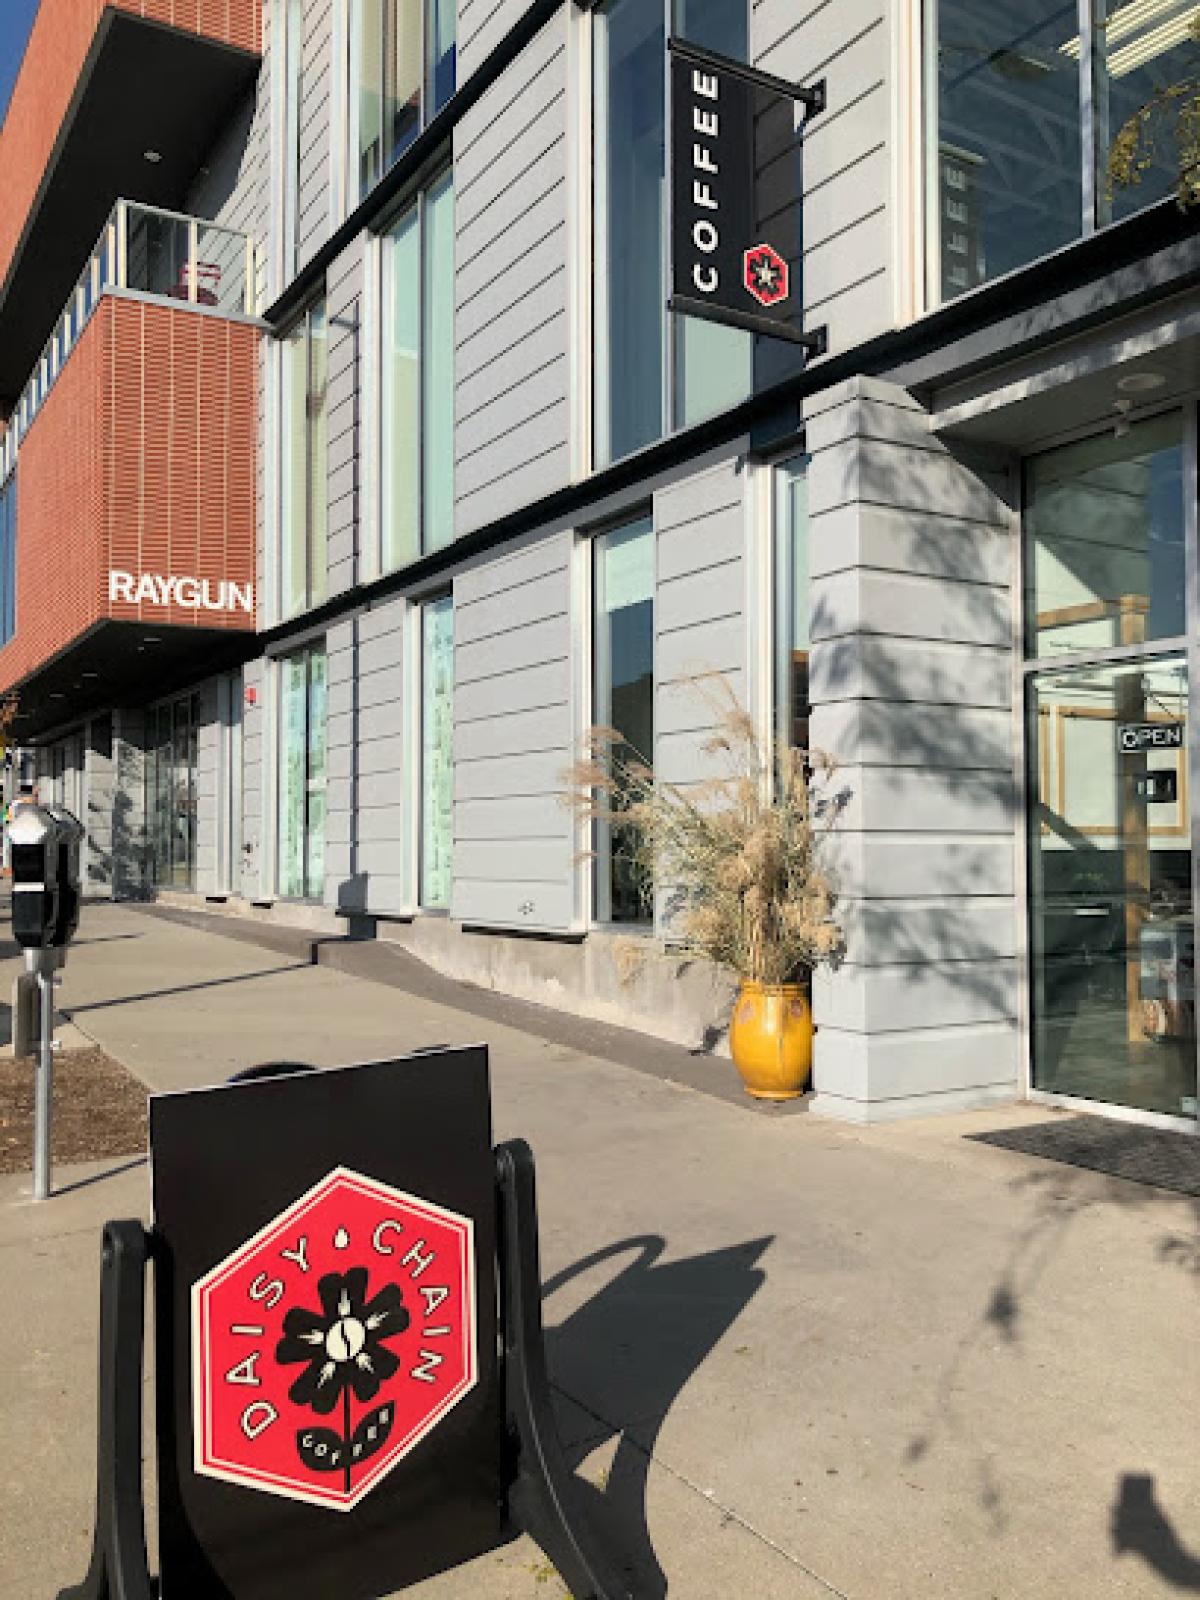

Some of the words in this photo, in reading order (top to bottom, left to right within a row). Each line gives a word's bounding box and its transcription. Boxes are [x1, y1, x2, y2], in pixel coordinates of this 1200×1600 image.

[692, 69, 718, 292] COFFEE
[108, 570, 253, 613] RAYGUN
[1122, 728, 1180, 747] OPEN
[225, 1236, 311, 1440] DAISY
[372, 1219, 451, 1383] CHAIN
